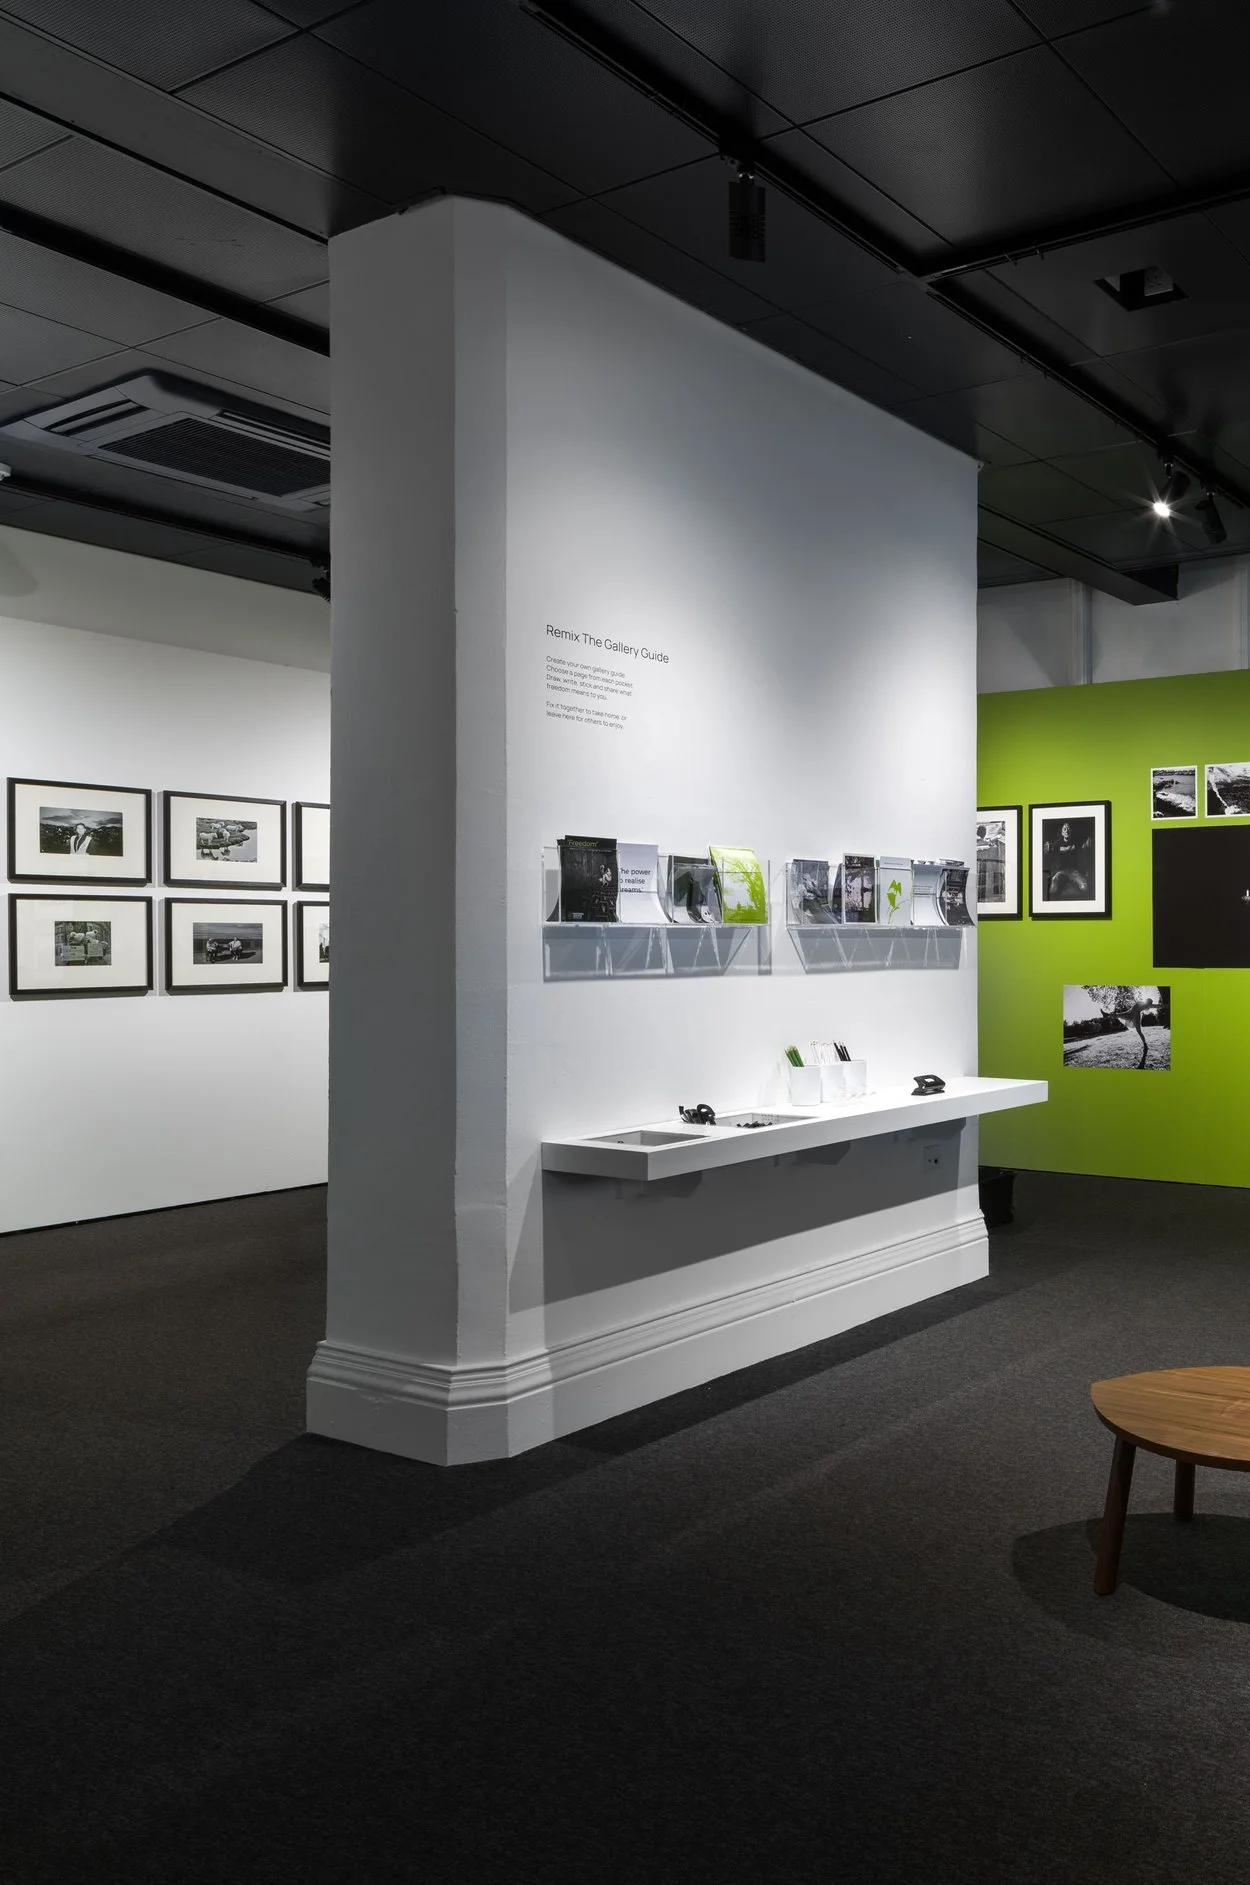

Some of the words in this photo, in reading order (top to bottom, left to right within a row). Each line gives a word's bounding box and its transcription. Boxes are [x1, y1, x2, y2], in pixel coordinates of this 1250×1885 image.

[547, 625, 580, 642] Remix
[582, 633, 602, 647] The
[605, 639, 638, 658] Gallery
[641, 648, 669, 663] Guide
[547, 656, 566, 665] Create
[567, 660, 579, 668] your
[592, 665, 609, 676] gallery
[547, 665, 568, 674] Choose
[574, 671, 588, 679] page
[547, 683, 570, 693] freedom
[572, 688, 589, 696] means
[580, 680, 591, 688] stick
[592, 683, 603, 691] and
[604, 686, 618, 694] share
[561, 704, 584, 714] together
[592, 709, 604, 717] take
[562, 713, 574, 721] here
[584, 717, 602, 725] others
